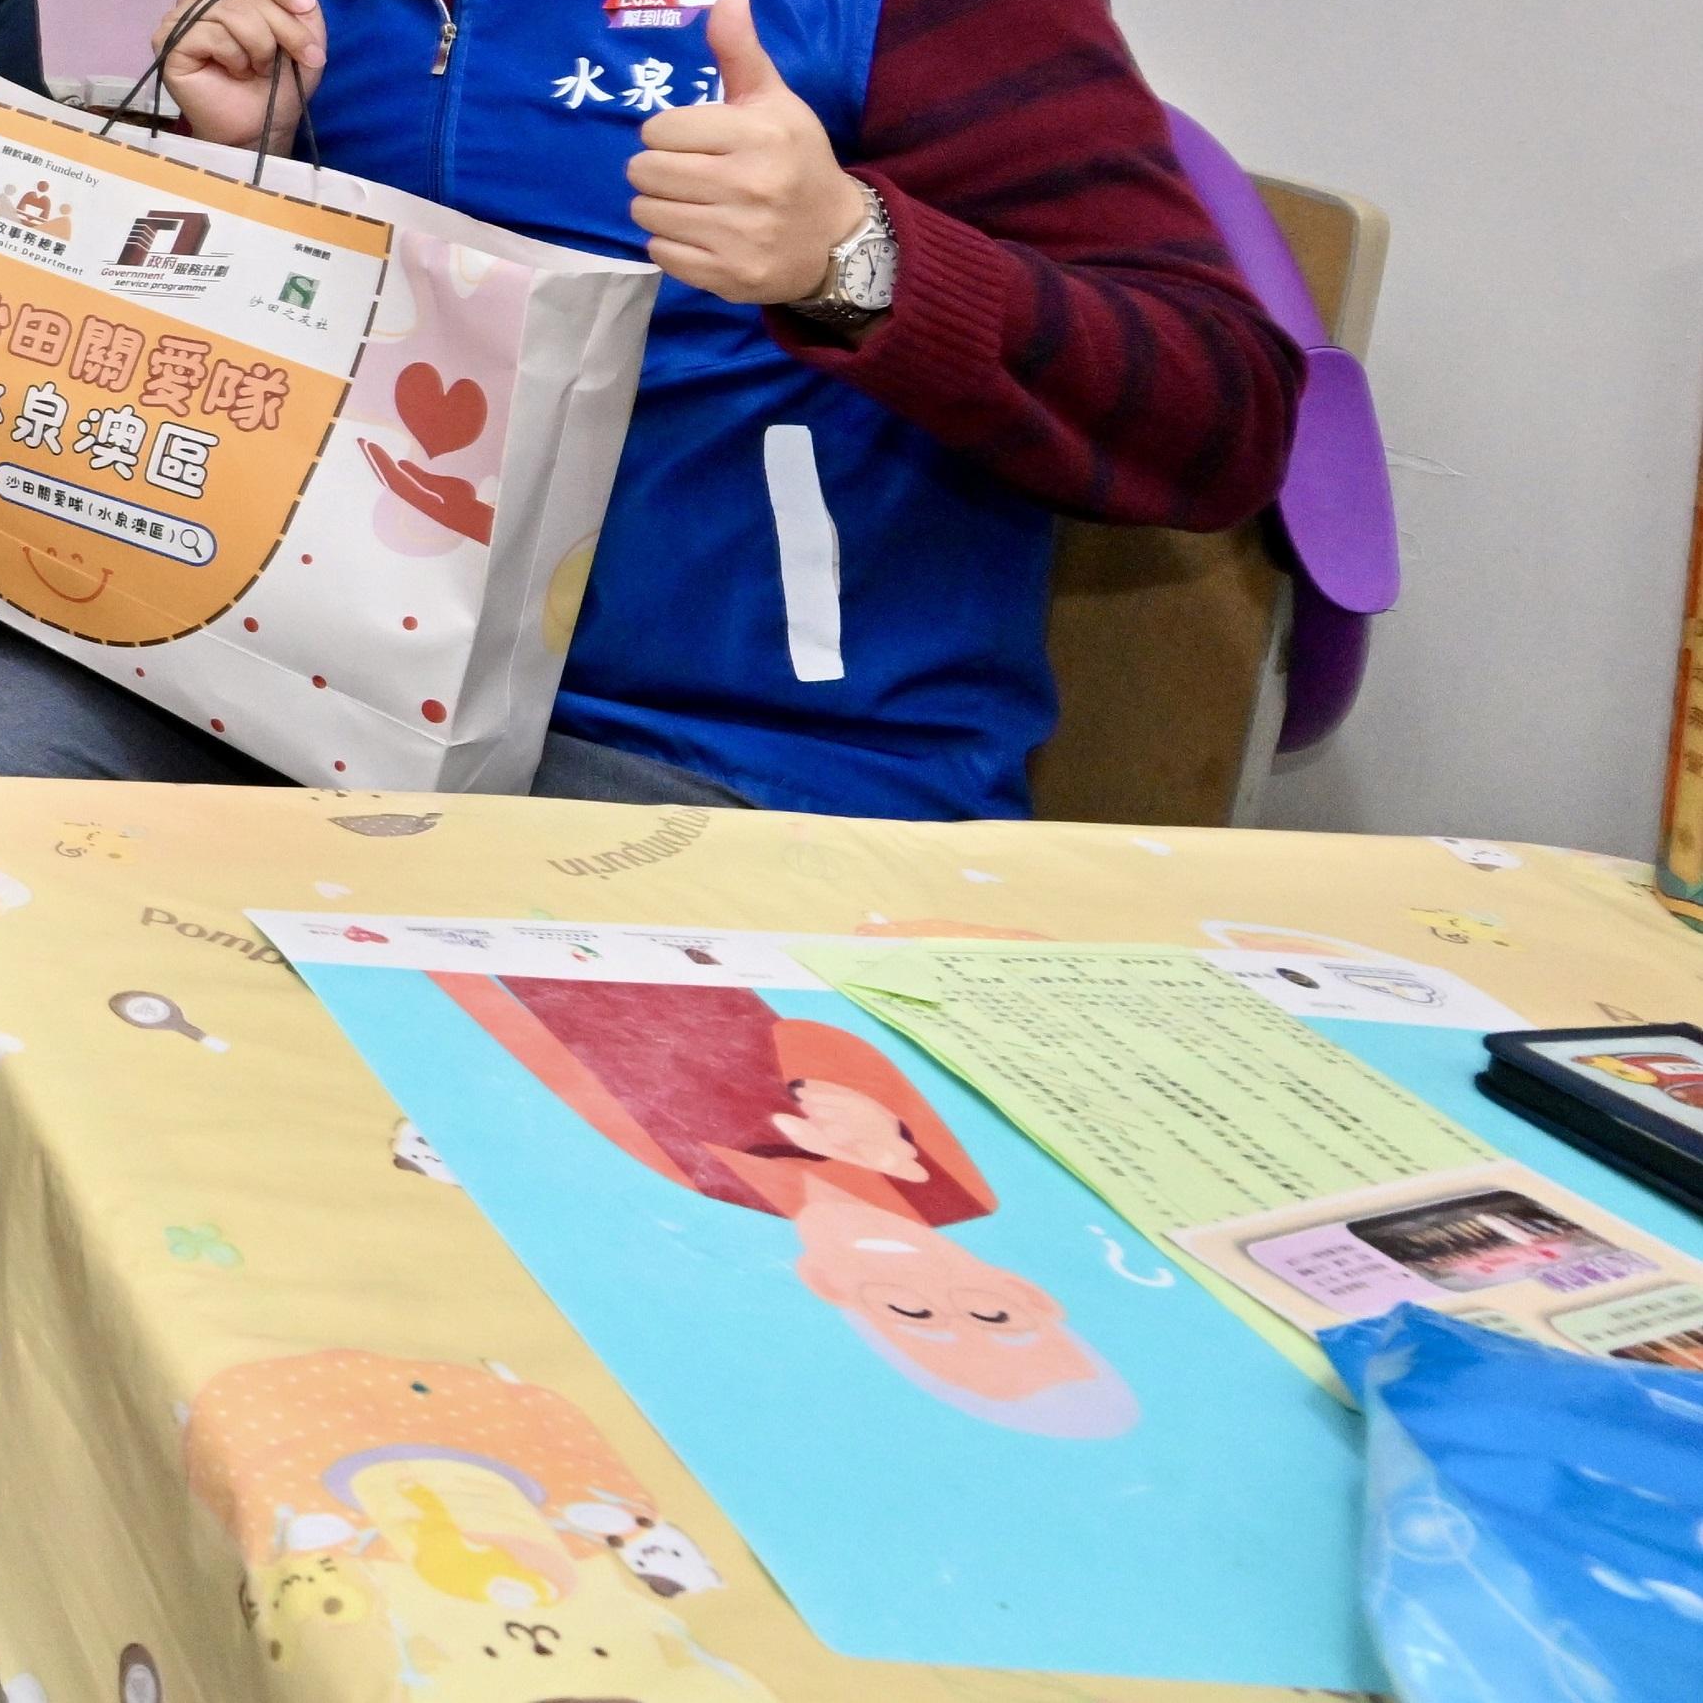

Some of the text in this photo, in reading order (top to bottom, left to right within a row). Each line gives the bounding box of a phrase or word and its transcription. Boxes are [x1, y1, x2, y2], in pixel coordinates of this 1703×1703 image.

[622, 8, 682, 28] 幫到你
[44, 160, 84, 181] Funded
[85, 173, 100, 187] by
[21, 246, 84, 276] Department
[146, 254, 229, 278] 政府服務計劃
[100, 267, 165, 281] Government
[114, 279, 207, 293] service programme
[249, 295, 329, 331] 沙田之友社
